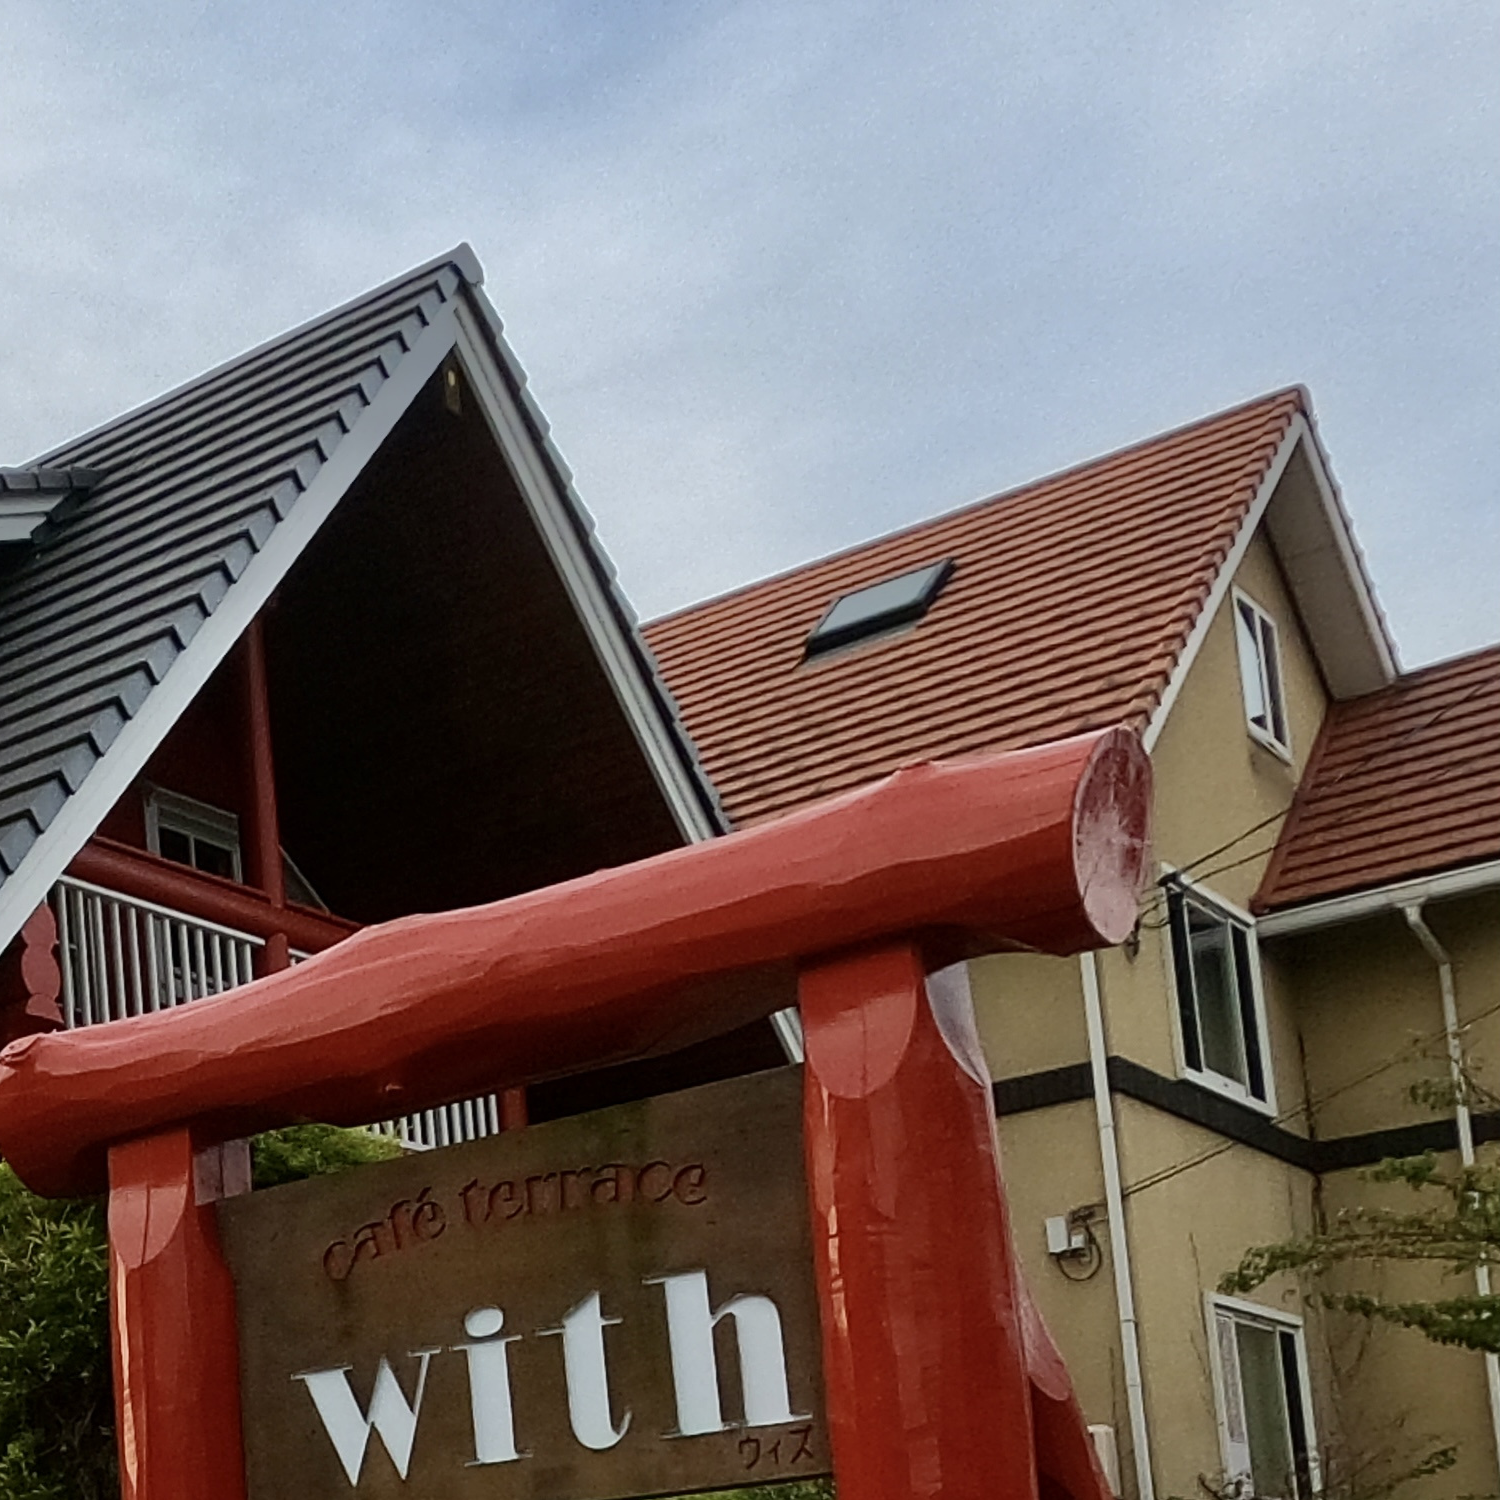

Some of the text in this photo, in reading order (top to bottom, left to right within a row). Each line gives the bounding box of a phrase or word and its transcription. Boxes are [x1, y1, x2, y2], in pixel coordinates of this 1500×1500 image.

[322, 1160, 708, 1282] café terrace
[289, 1268, 814, 1489] with
